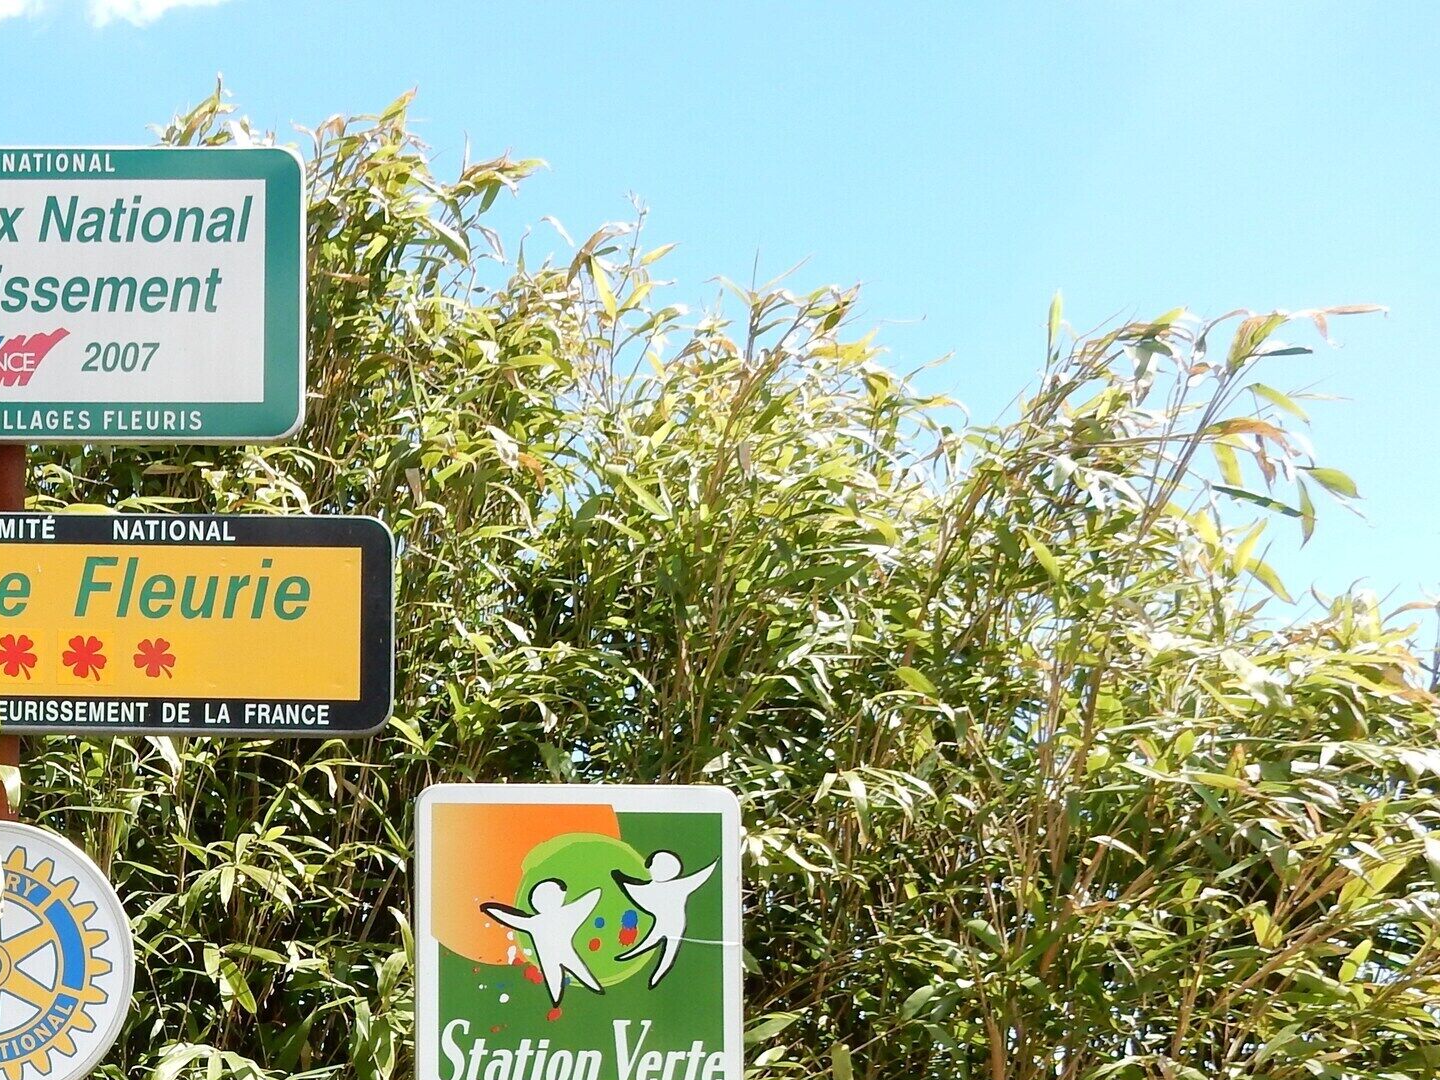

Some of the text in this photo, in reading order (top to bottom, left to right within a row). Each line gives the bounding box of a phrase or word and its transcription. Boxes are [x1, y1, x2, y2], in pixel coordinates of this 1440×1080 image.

[2, 152, 116, 173] NATIONAL
[38, 195, 253, 243] National
[81, 342, 160, 373] 2007
[103, 411, 204, 431] FLEURIS
[112, 519, 236, 541] NATIONAL
[73, 556, 311, 620] Fleurie
[162, 702, 189, 723] DE
[204, 702, 231, 724] LA
[244, 703, 330, 725] FRANCE
